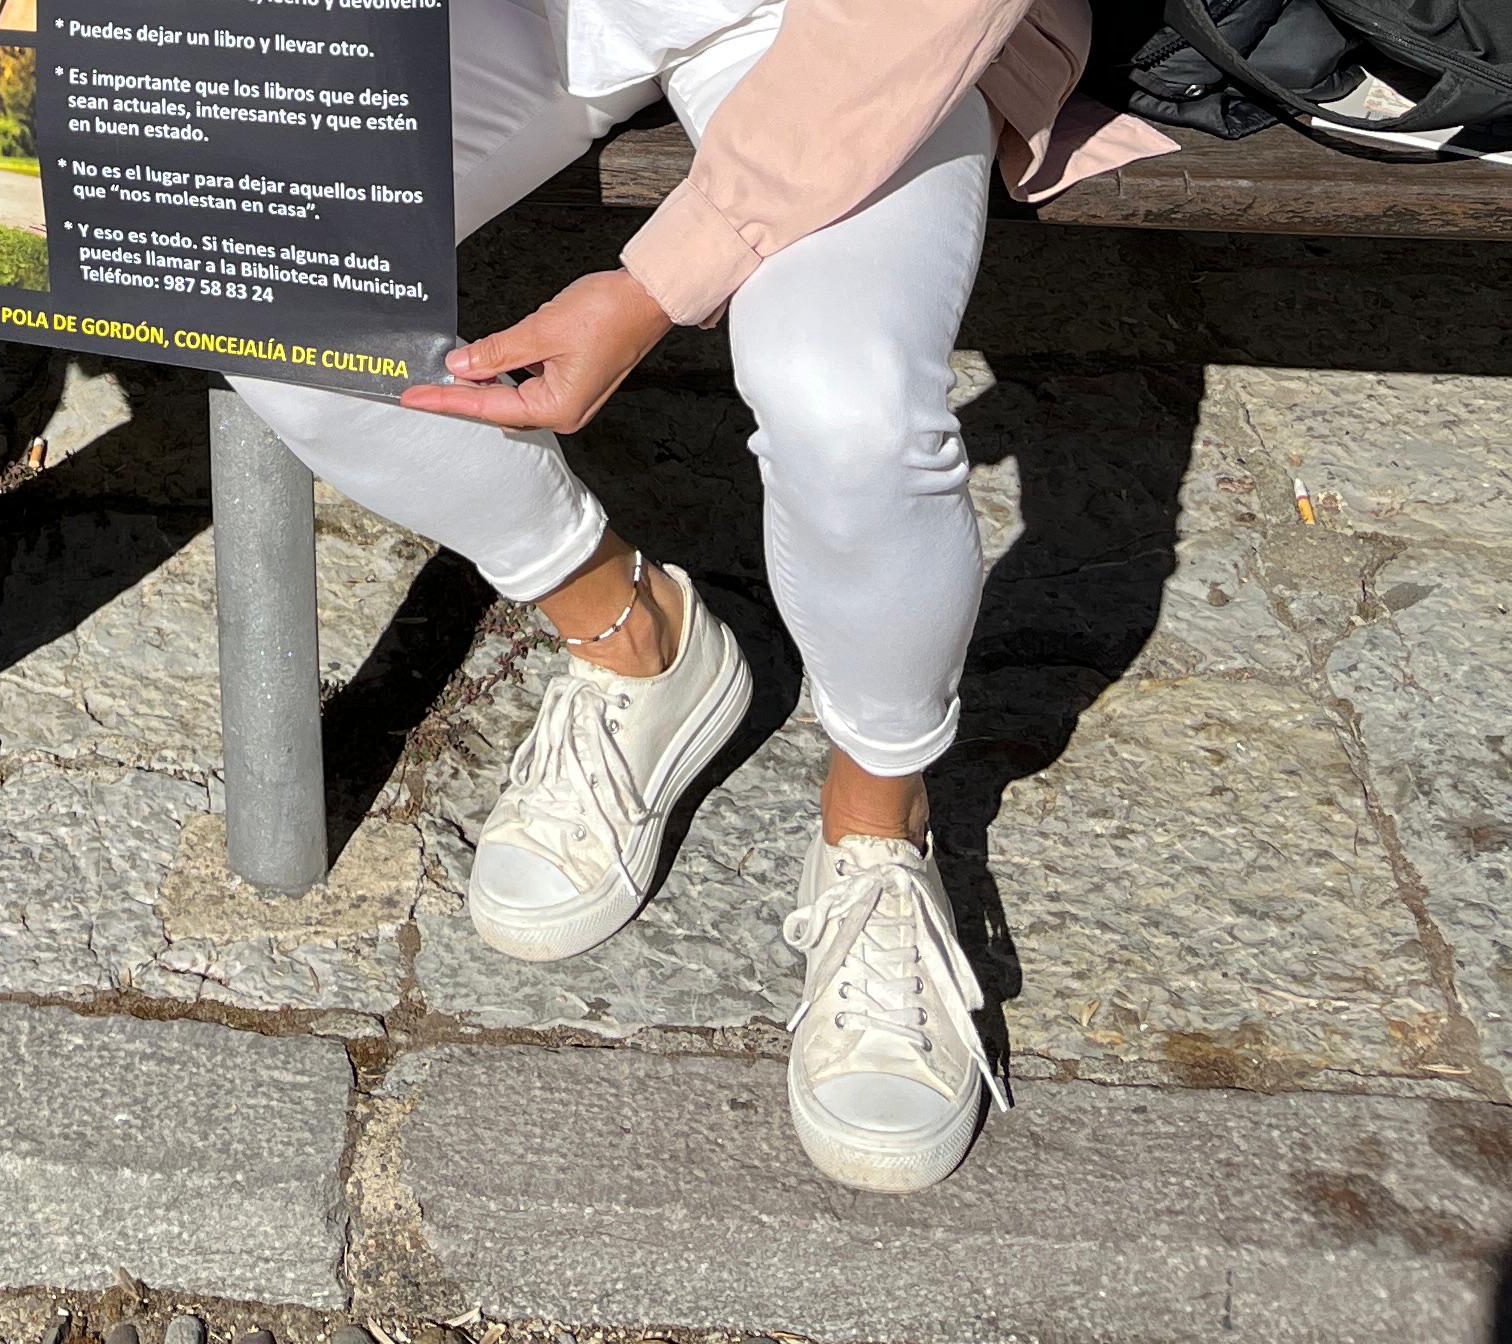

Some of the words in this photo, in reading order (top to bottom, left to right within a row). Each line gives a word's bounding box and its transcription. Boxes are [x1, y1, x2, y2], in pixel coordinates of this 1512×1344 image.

[68, 19, 133, 41] Puedes
[135, 23, 184, 47] dejar
[186, 31, 210, 47] un
[213, 29, 256, 50] libro
[258, 36, 272, 55] y
[274, 33, 326, 55] llevar
[328, 40, 375, 58] otro.
[68, 67, 89, 86] Es
[91, 68, 192, 94] importante
[194, 80, 230, 99] que
[233, 78, 261, 99] los
[263, 81, 316, 103] libros
[318, 89, 355, 108] que
[358, 87, 410, 111] dejes
[67, 94, 109, 111] sean
[112, 97, 192, 121] actuales,
[195, 100, 308, 126] interesantes
[310, 113, 323, 131] y
[325, 114, 363, 132] que
[365, 112, 418, 132] estén
[67, 118, 91, 133] en
[94, 115, 140, 137] buen
[143, 123, 210, 143] estado.
[71, 160, 98, 177] No
[101, 165, 122, 180] es
[124, 164, 142, 181] el
[145, 165, 191, 188] lugar
[194, 173, 235, 190] para
[237, 173, 286, 196] dejar
[288, 181, 367, 202] aquellos
[370, 184, 424, 205] libros
[72, 184, 107, 201] que
[154, 190, 238, 211] molestan
[240, 199, 264, 214] en
[76, 222, 90, 238] Y
[93, 227, 125, 242] eso
[127, 230, 148, 245] es
[150, 230, 199, 250] todo.
[201, 235, 218, 252] Si
[220, 237, 277, 259] tienes
[279, 244, 340, 267] alguna
[343, 251, 391, 273] duda
[79, 246, 143, 265] puedes
[145, 249, 202, 272] llamar
[204, 260, 217, 274] a
[219, 257, 237, 276] la
[240, 261, 329, 288] Biblioteca
[332, 272, 429, 302] Municipal,
[79, 264, 160, 290] Teléfono:
[162, 274, 196, 294] 987
[199, 278, 223, 297] 58
[225, 281, 249, 301] 83
[251, 284, 275, 304] 24
[1, 306, 50, 330] POLA
[52, 313, 78, 333] DE
[80, 317, 170, 349] GORDÓN,
[173, 329, 288, 363] CONCEJALÍA
[290, 344, 318, 367] DE
[321, 356, 409, 379] CULTURA
